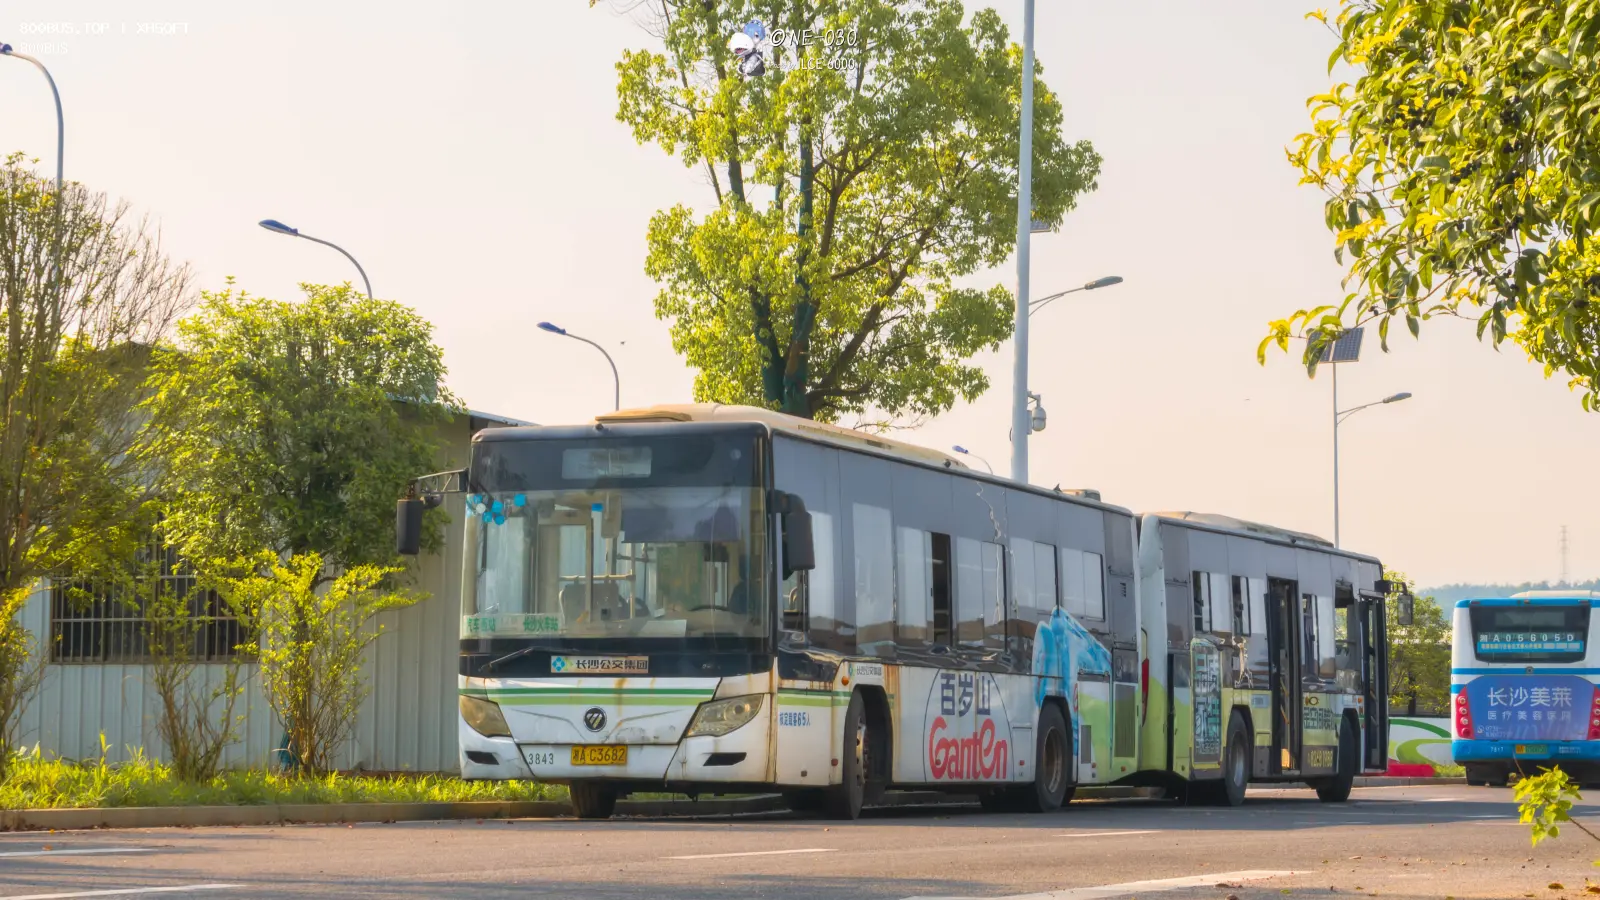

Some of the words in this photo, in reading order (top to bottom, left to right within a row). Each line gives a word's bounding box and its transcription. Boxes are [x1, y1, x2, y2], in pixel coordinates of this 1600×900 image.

[575, 659, 648, 670] 长沙公交集团
[940, 671, 992, 718] 百岁山
[1488, 687, 1572, 707] 长沙美莱
[928, 715, 1008, 780] Ganten
[528, 753, 554, 765] 3843
